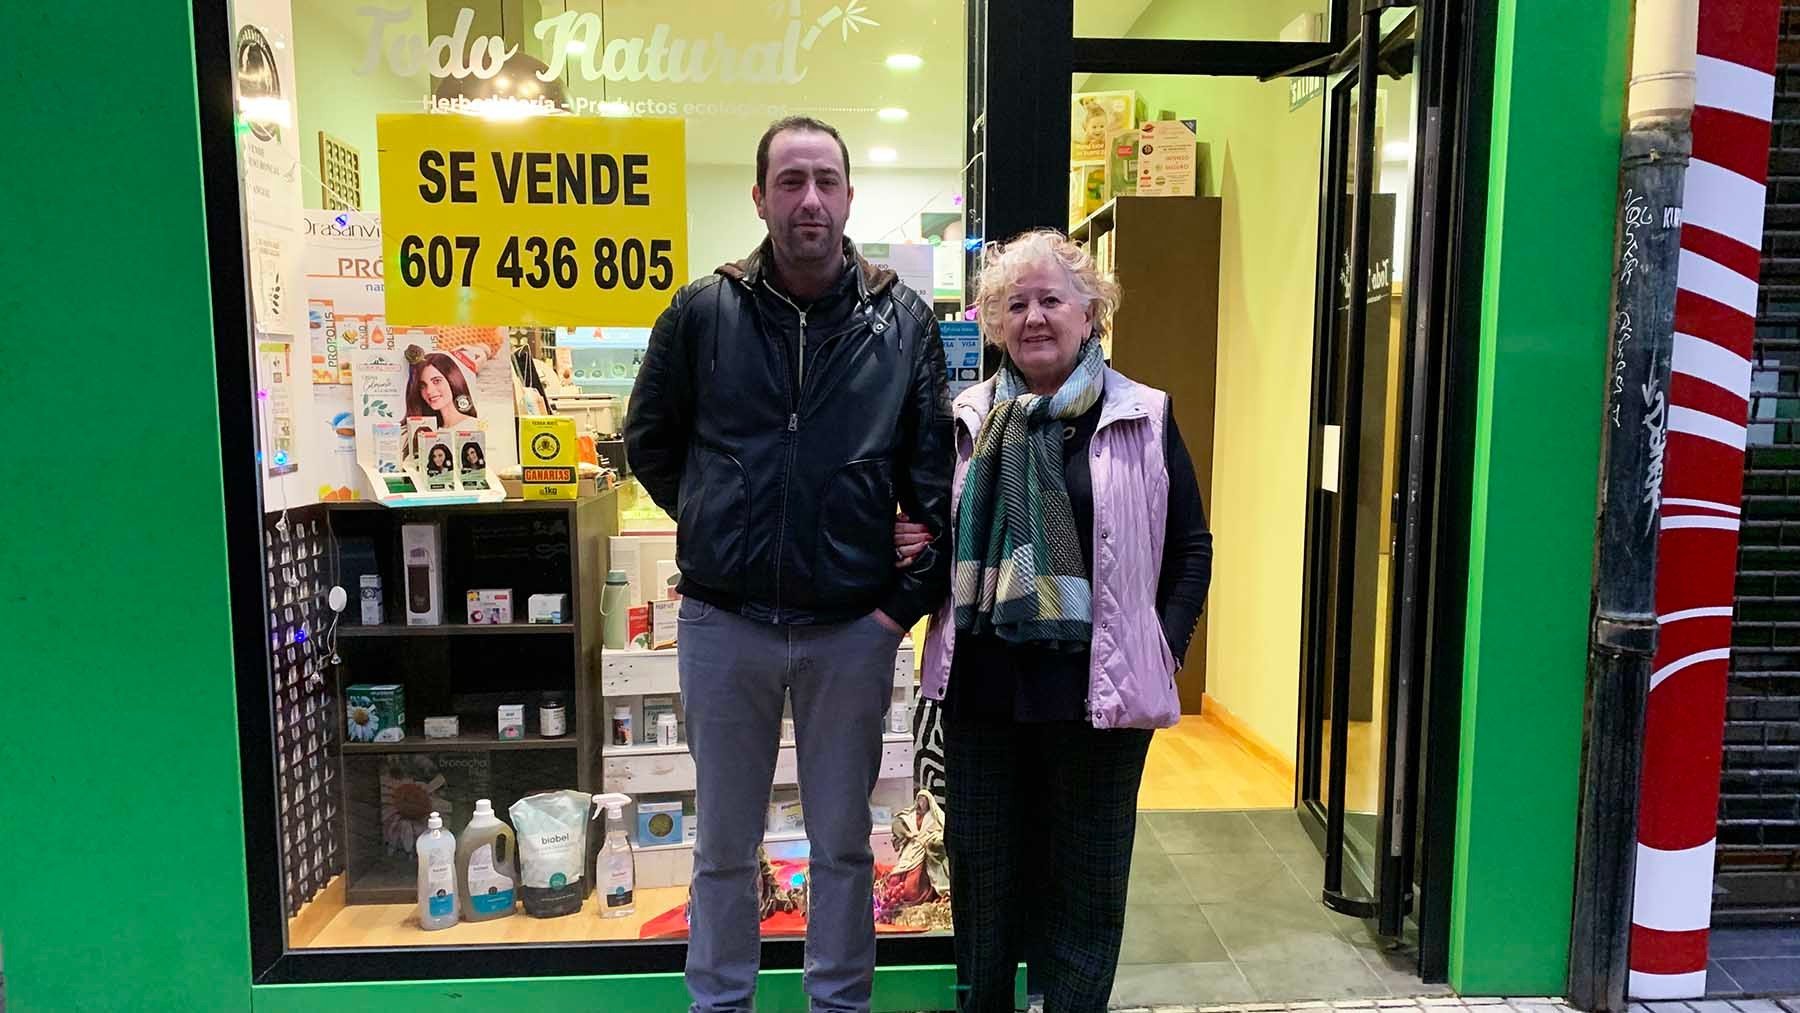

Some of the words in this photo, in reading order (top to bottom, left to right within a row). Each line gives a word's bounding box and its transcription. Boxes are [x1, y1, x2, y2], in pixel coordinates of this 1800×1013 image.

[352, 7, 519, 79] Todo
[533, 9, 807, 85] Natural
[423, 94, 556, 114] Herboitría
[683, 99, 786, 114] ecolgos
[418, 150, 477, 203] SE
[491, 151, 650, 206] VENDE
[400, 234, 480, 288] 607
[496, 235, 578, 289] 436
[594, 237, 673, 290] 805
[325, 311, 337, 368] PROPOLIS
[526, 470, 570, 481] CANARIAS
[541, 833, 569, 845] biobel
